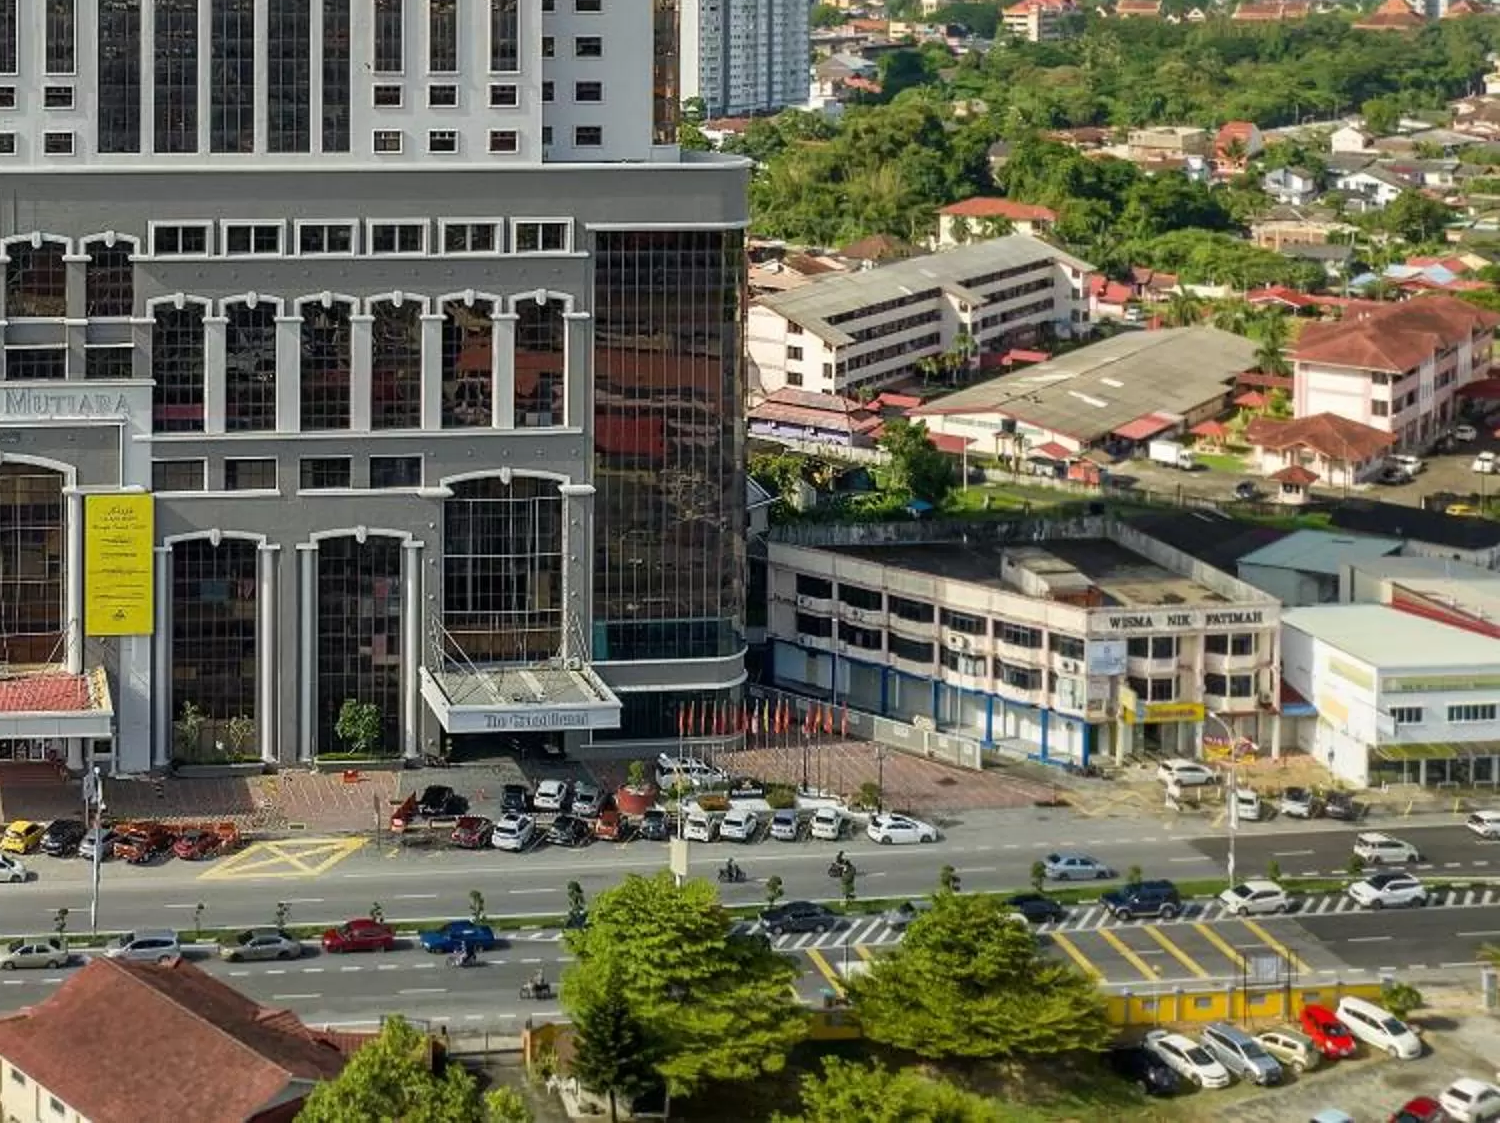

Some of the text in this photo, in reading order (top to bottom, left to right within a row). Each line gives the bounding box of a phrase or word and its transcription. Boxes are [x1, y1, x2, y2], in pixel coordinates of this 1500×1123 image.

[6, 388, 131, 417] MUTIARA
[1109, 611, 1262, 629] WISMA NIK FATIMAH
